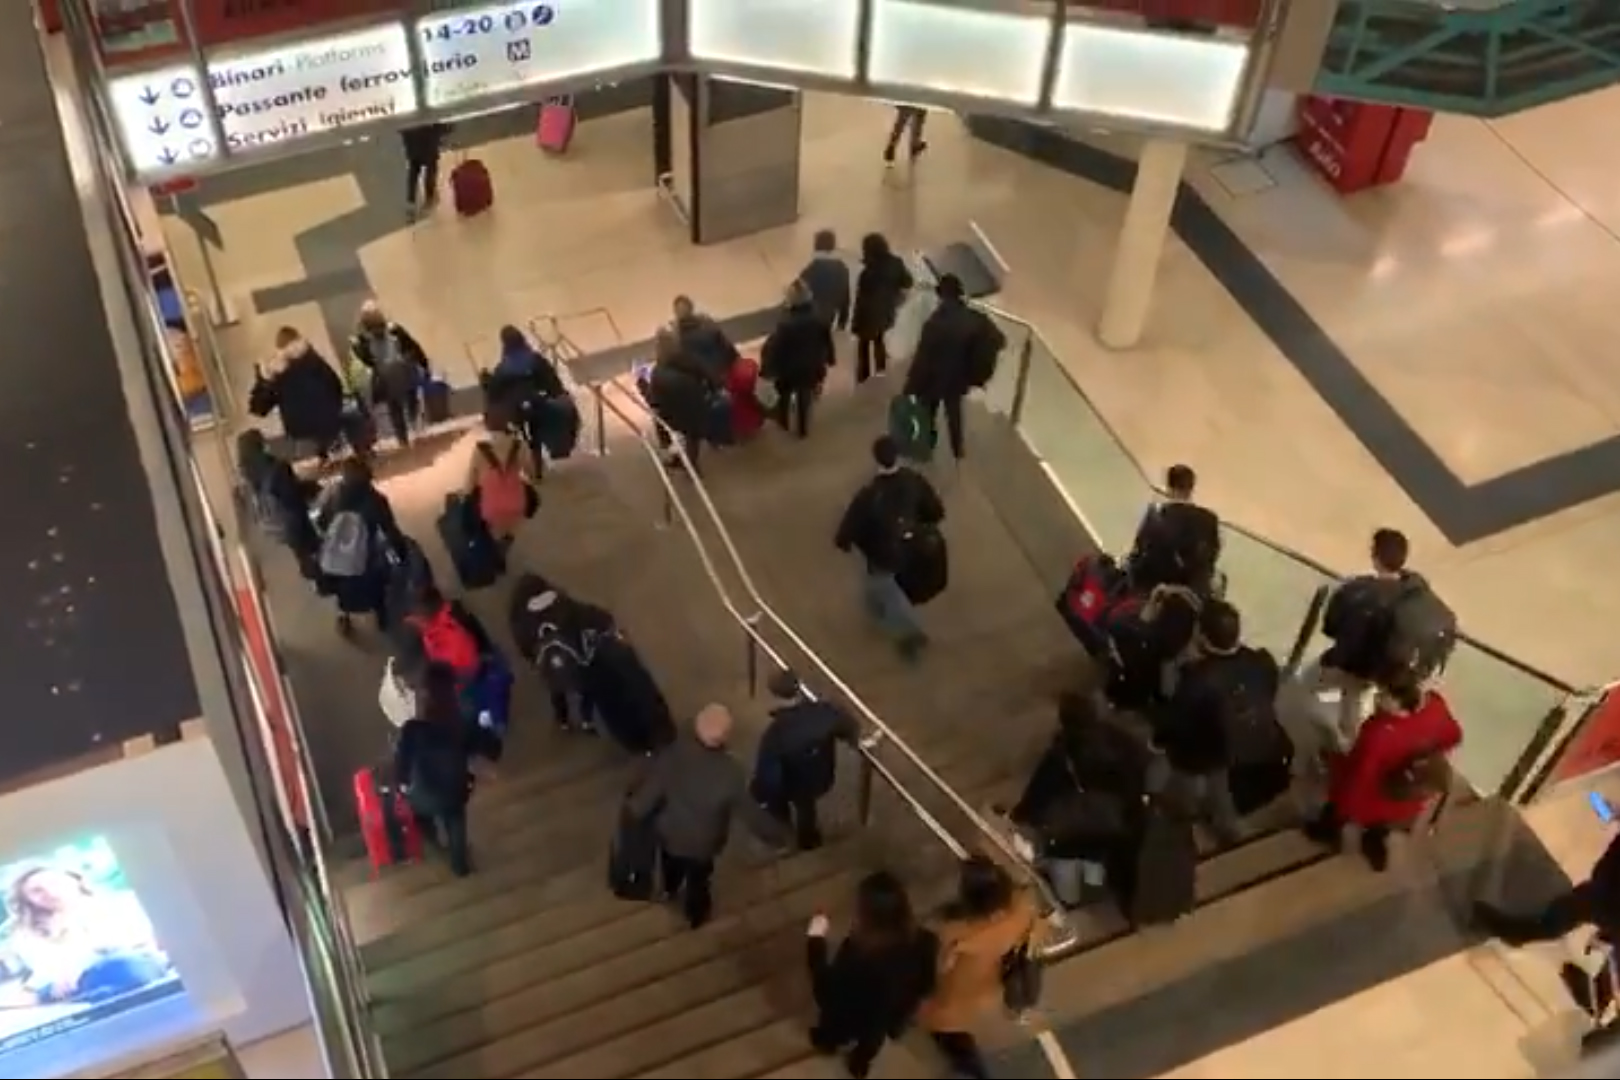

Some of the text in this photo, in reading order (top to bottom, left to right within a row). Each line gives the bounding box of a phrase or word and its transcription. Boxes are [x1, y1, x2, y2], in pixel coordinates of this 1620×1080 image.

[208, 58, 285, 90] Binari
[424, 16, 493, 42] 14-20
[216, 85, 327, 119] Passante
[228, 116, 308, 147] Servizi
